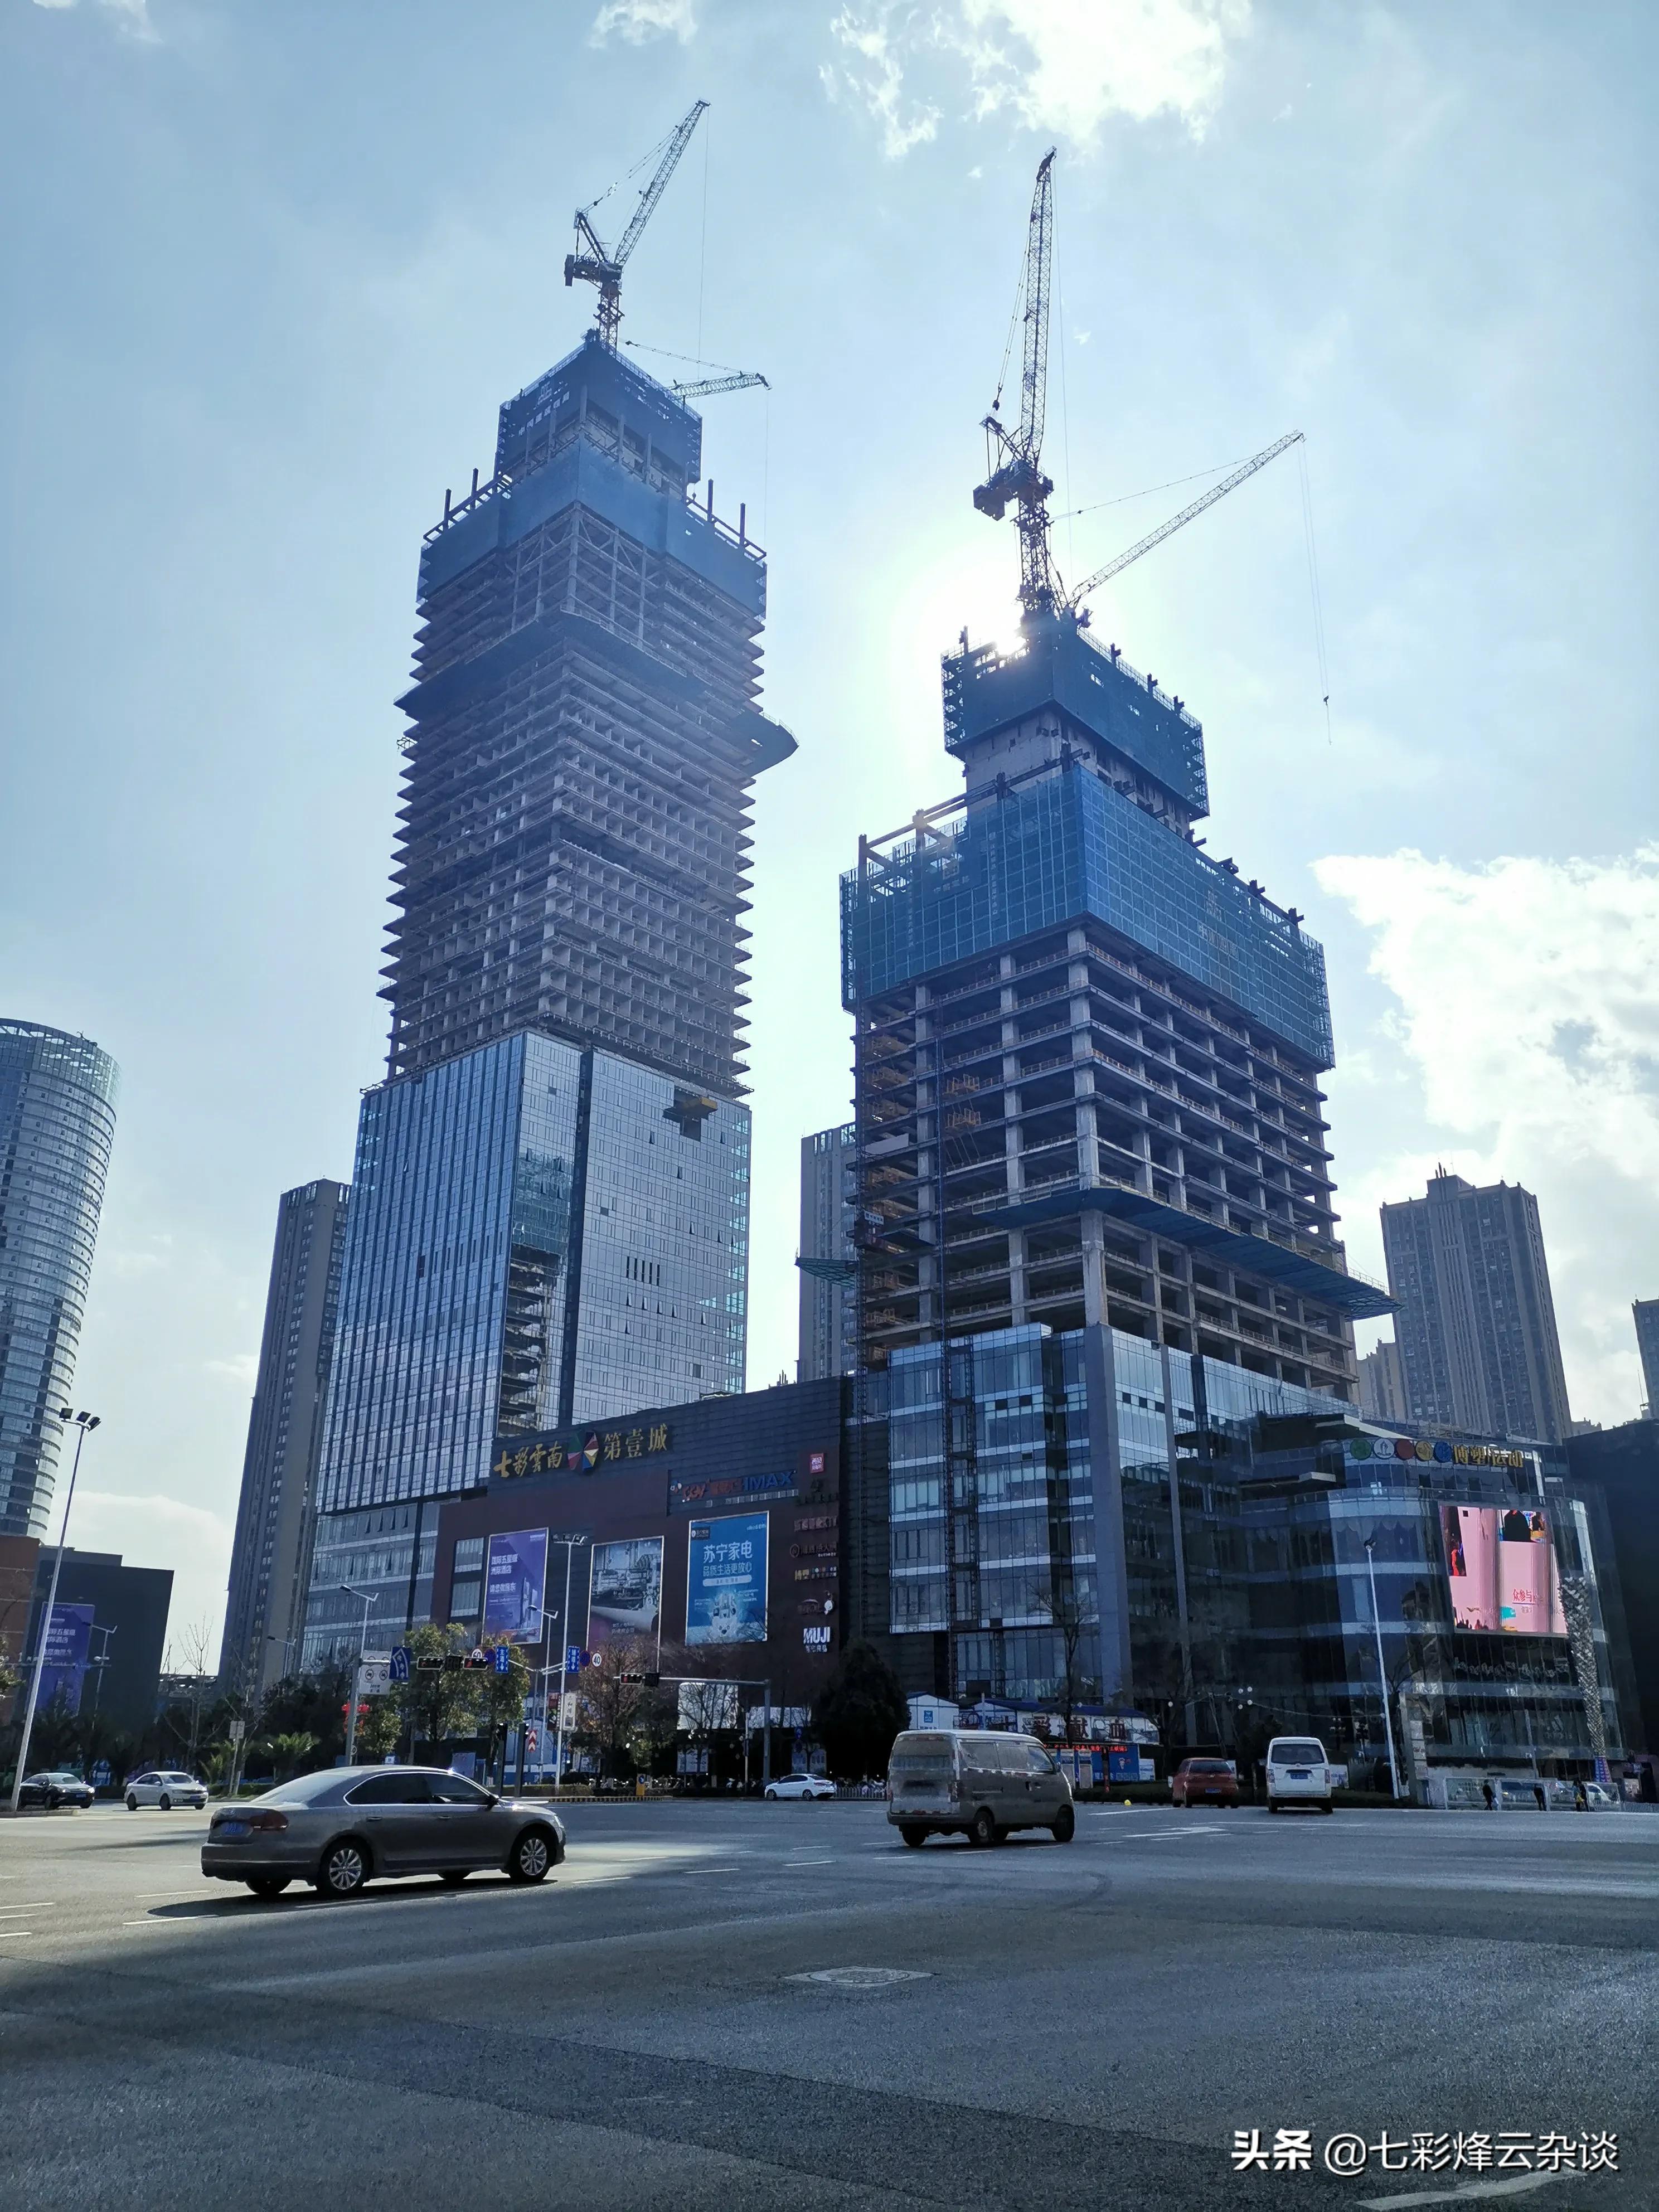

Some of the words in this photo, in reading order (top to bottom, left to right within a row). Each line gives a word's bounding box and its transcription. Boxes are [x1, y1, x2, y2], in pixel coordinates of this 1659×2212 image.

[604, 1423, 668, 1461] 第壹城
[744, 1471, 794, 1491] IMAX
[703, 1540, 753, 1563] 苏宁家电
[703, 1561, 752, 1577] 品质生活更放心
[803, 1626, 831, 1645] MUJI
[593, 1655, 601, 1665] 40
